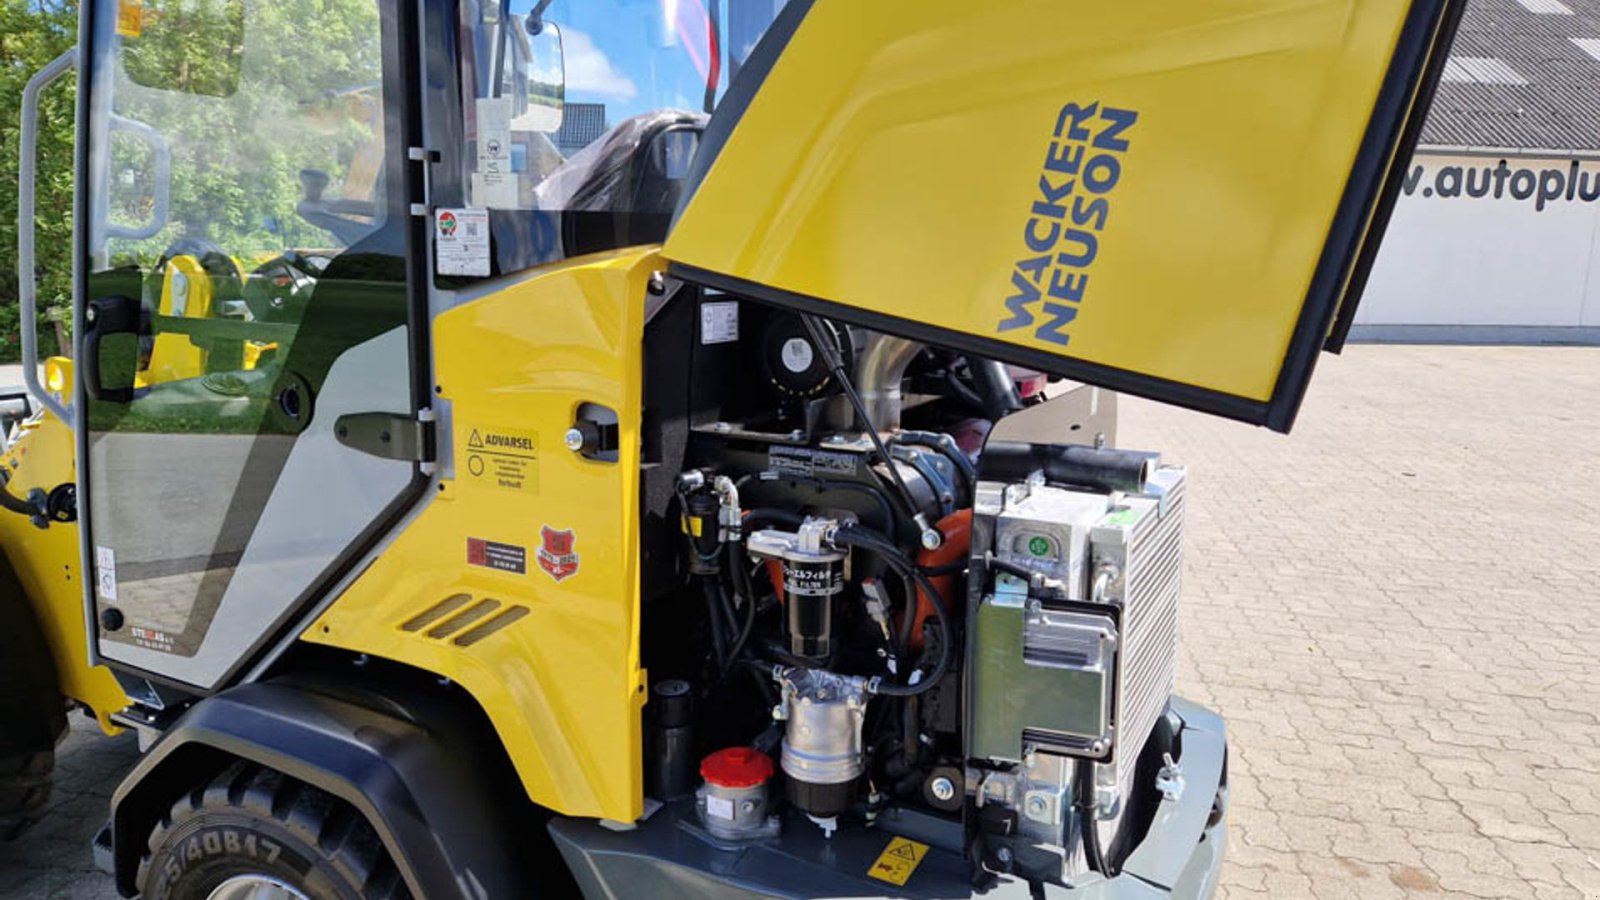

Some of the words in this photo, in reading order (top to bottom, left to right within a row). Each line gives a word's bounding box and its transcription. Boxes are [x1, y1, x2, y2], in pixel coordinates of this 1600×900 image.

[997, 101, 1099, 332] WACKER
[1034, 107, 1139, 346] NEUSON
[485, 434, 534, 450] ADVARSEL
